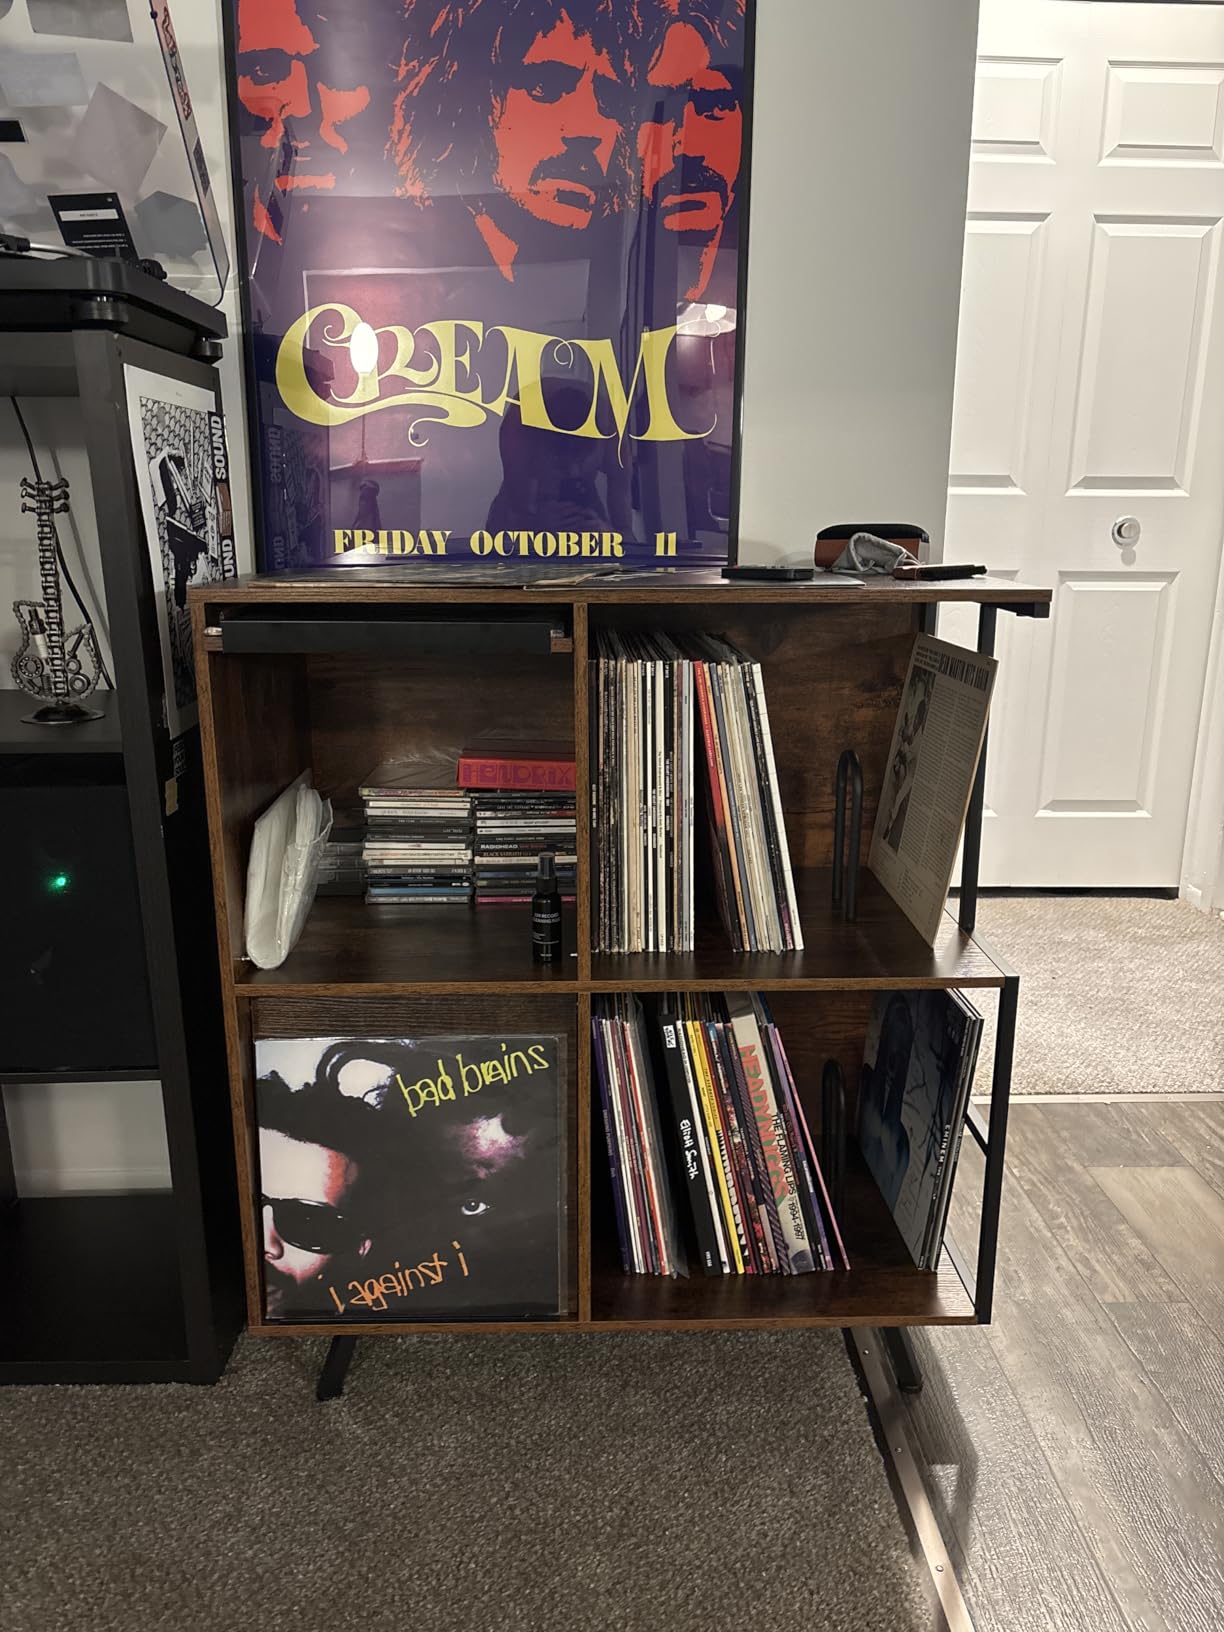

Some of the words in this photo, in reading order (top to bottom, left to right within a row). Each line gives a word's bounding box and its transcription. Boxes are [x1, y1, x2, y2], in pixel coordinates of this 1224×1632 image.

[275, 302, 717, 468] CREAM
[210, 415, 227, 480] SOUND
[222, 538, 236, 579] UND
[332, 529, 454, 557] FRIDAY
[469, 529, 625, 558] OCTOBER
[654, 531, 678, 557] 11
[396, 1059, 456, 1118] bad
[456, 1043, 550, 1097] brains
[771, 1113, 780, 1134] THE
[939, 1124, 951, 1163] EMINEM
[775, 1133, 792, 1176] FLAMING
[785, 1175, 797, 1196] LIPS
[347, 1252, 449, 1311] against
